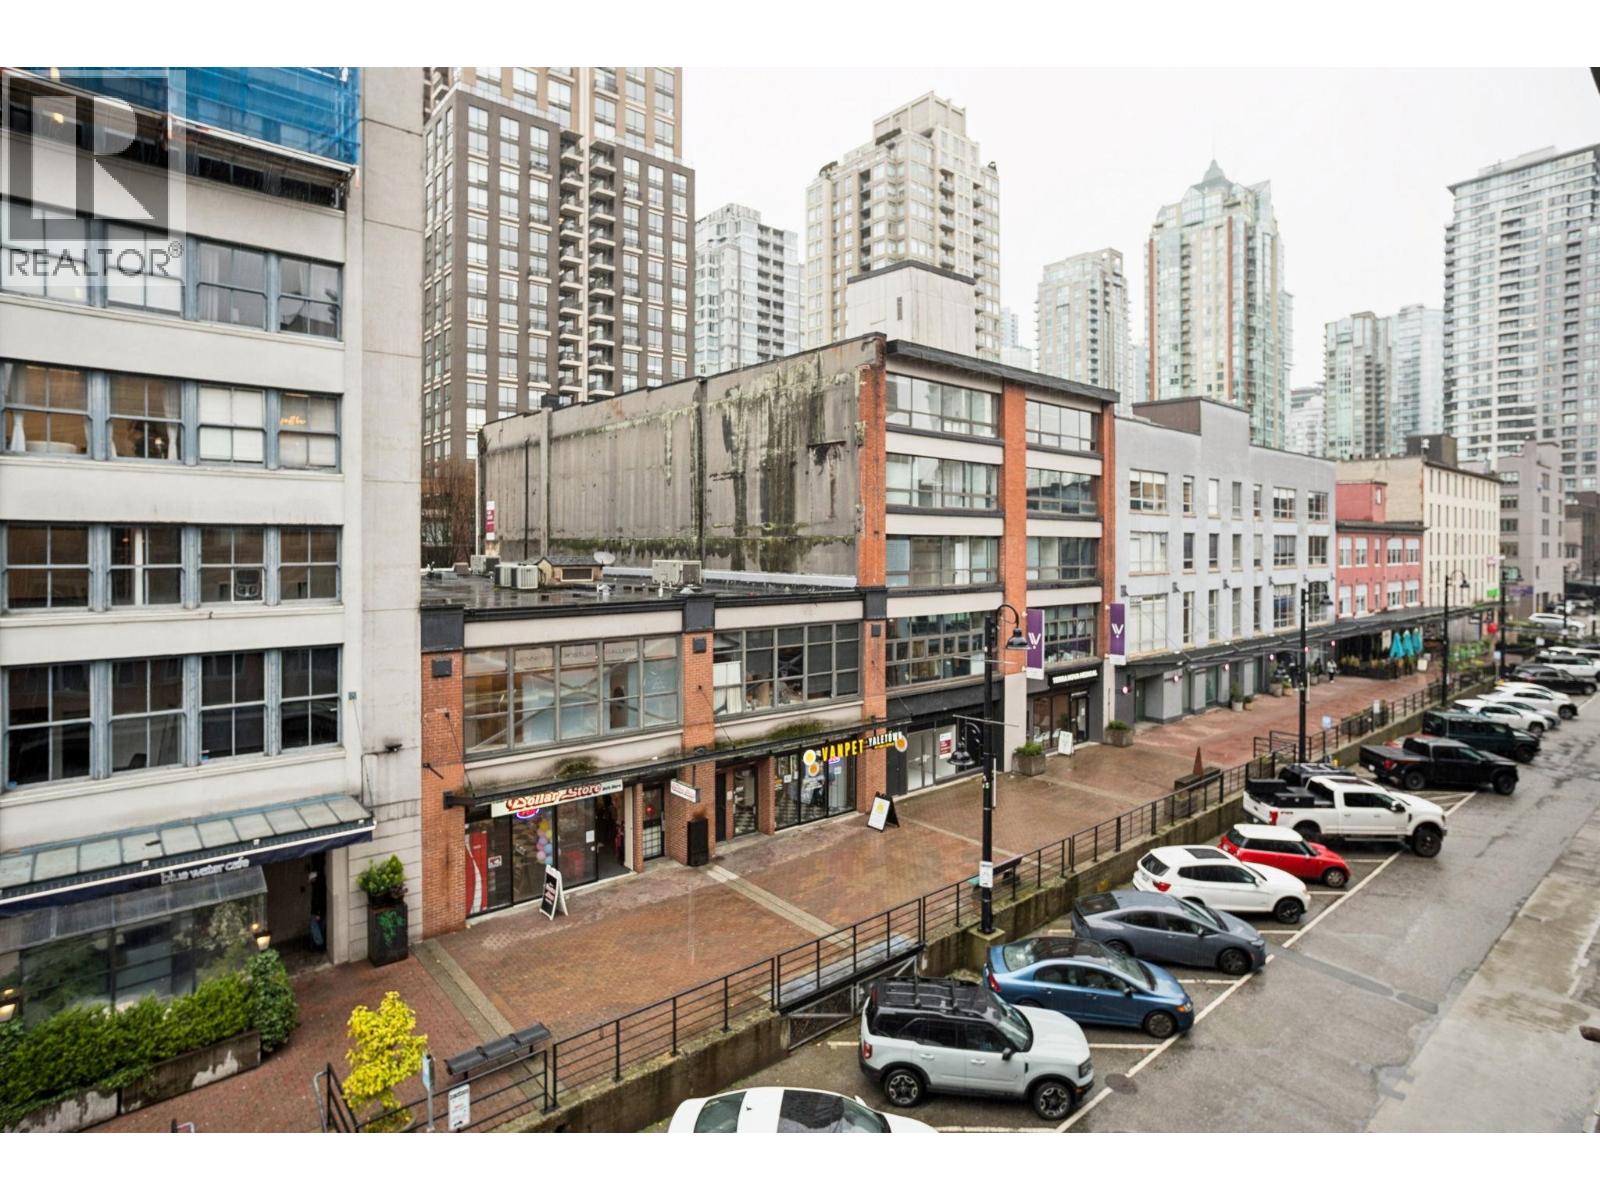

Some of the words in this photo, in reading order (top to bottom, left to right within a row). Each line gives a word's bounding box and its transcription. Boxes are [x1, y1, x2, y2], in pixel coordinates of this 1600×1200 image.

[821, 739, 864, 762] VANPET
[506, 791, 561, 811] Dollar
[562, 783, 603, 799] Store
[160, 870, 189, 885] blue
[190, 863, 224, 878] water
[225, 856, 250, 871] cafe
